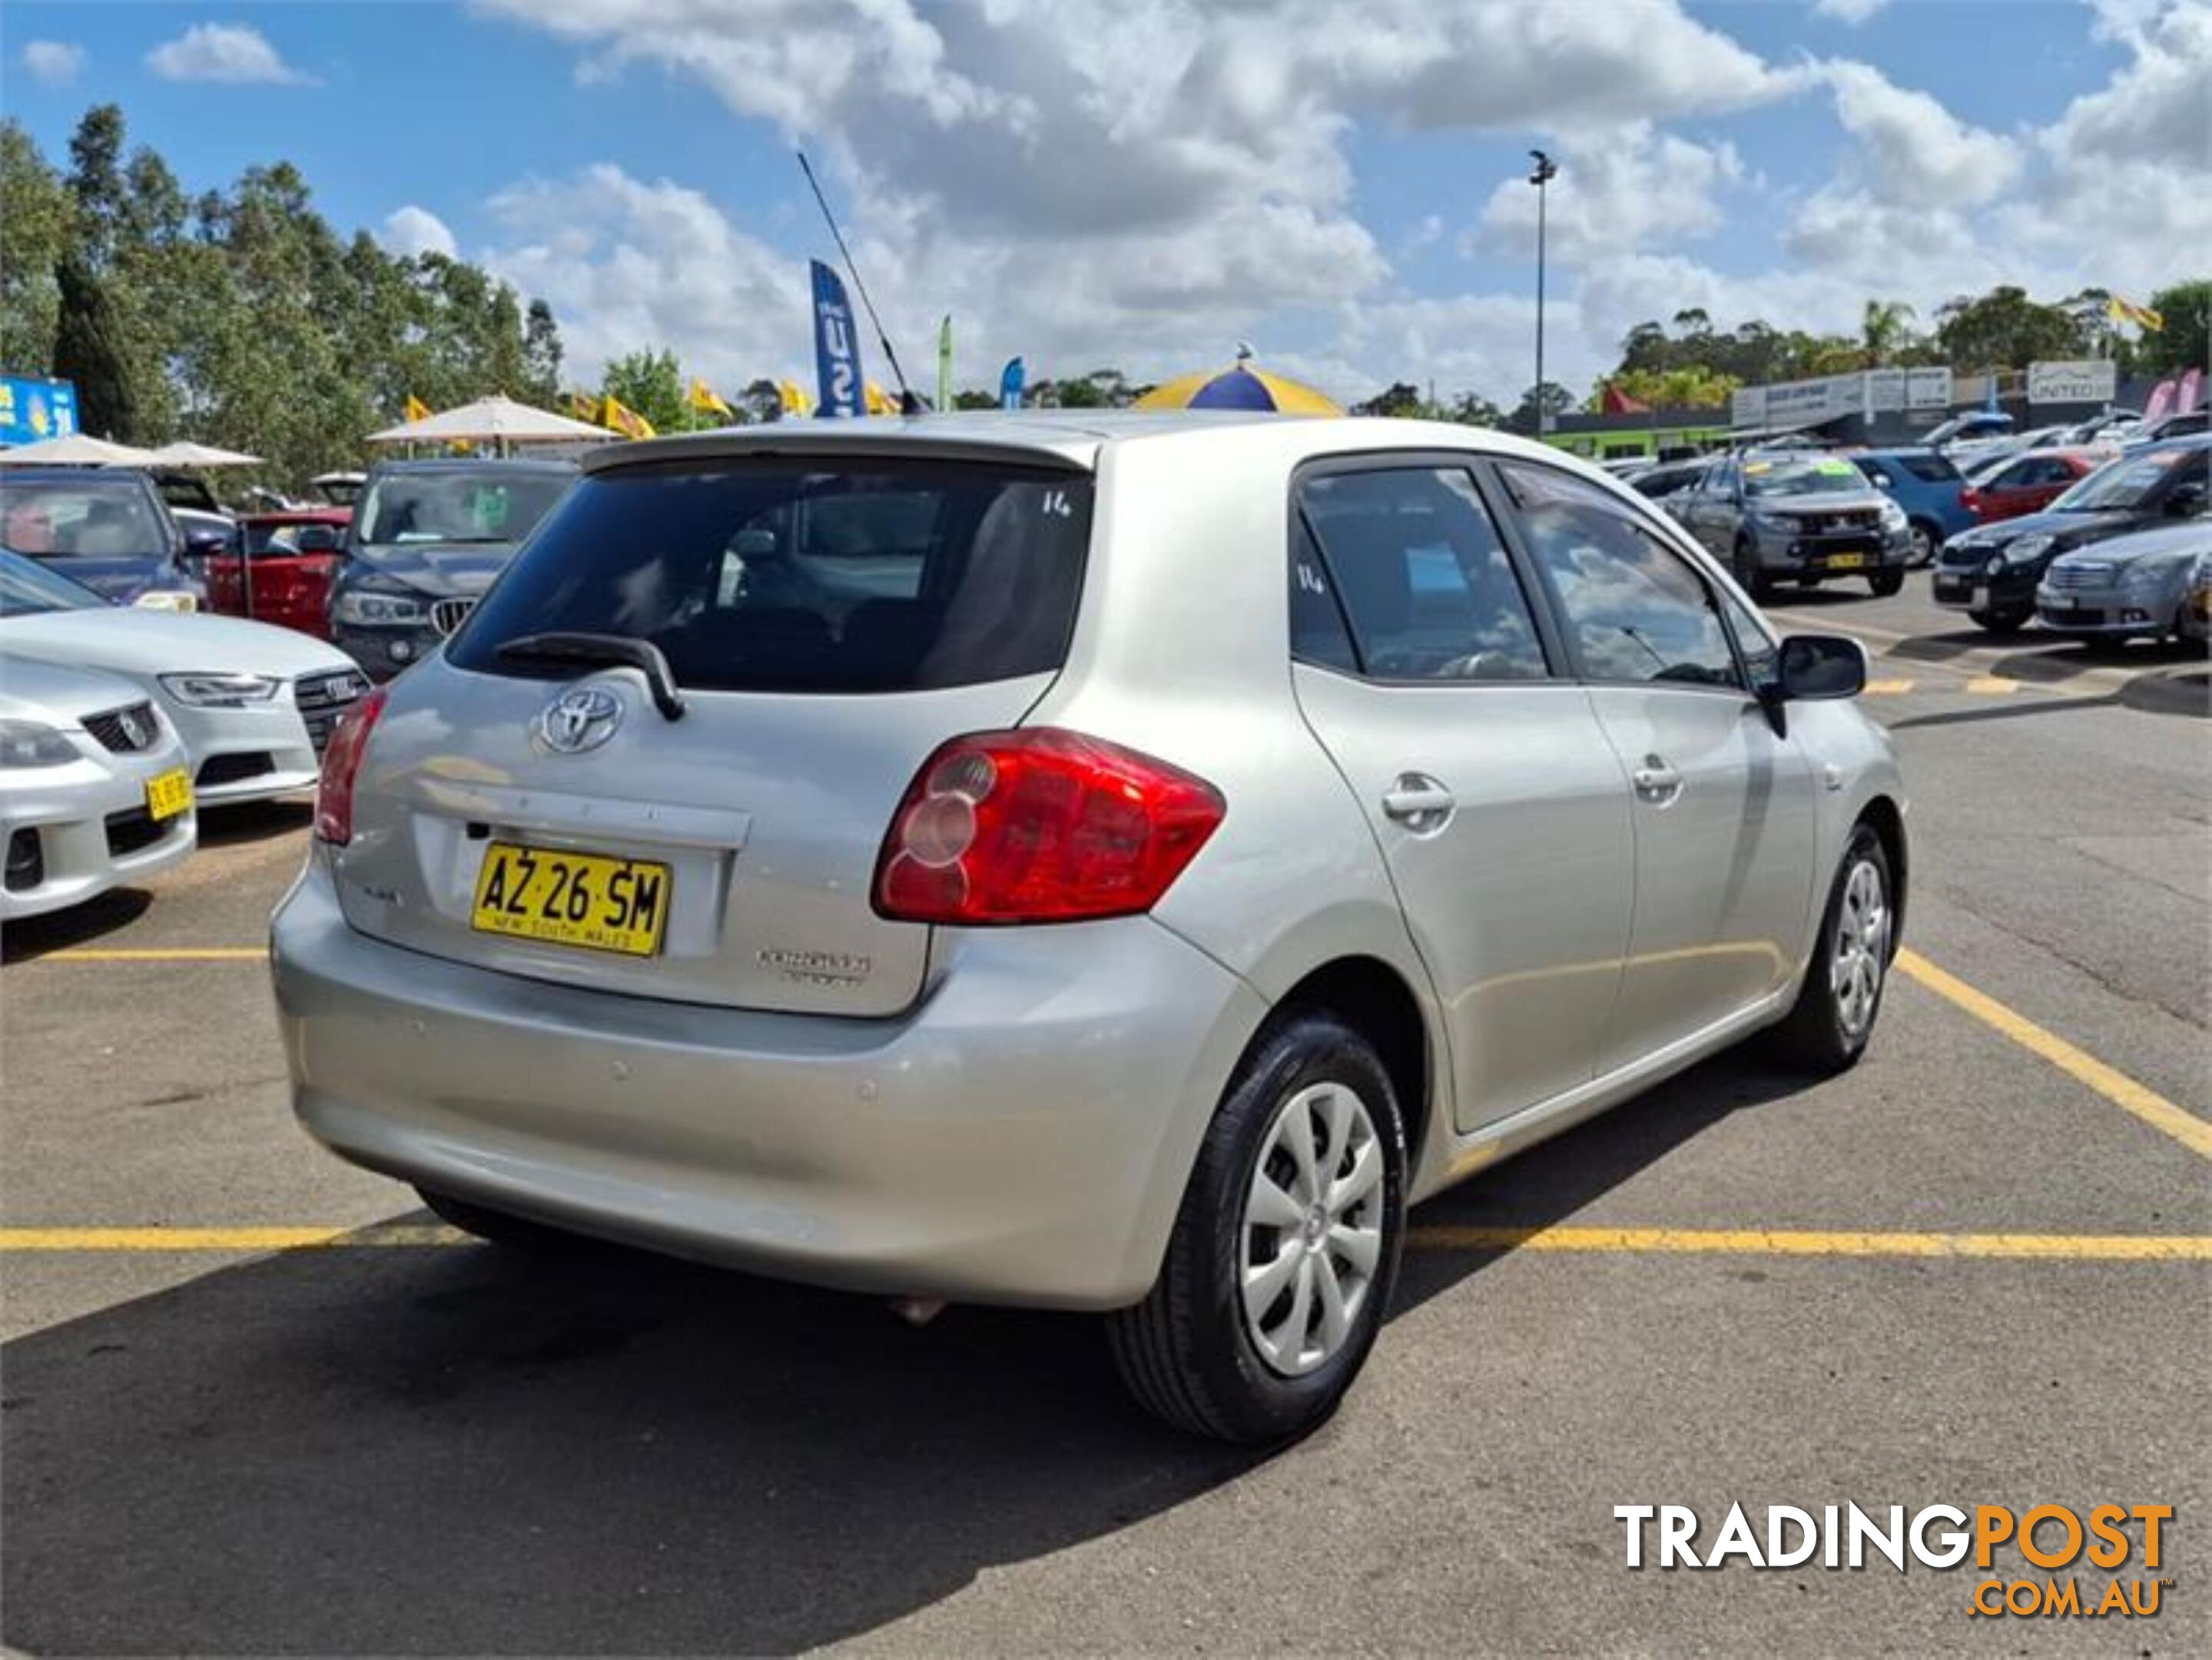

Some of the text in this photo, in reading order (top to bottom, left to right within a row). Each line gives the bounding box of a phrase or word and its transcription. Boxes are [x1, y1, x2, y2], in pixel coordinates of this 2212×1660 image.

[482, 855, 661, 933] AZ 26 SM
